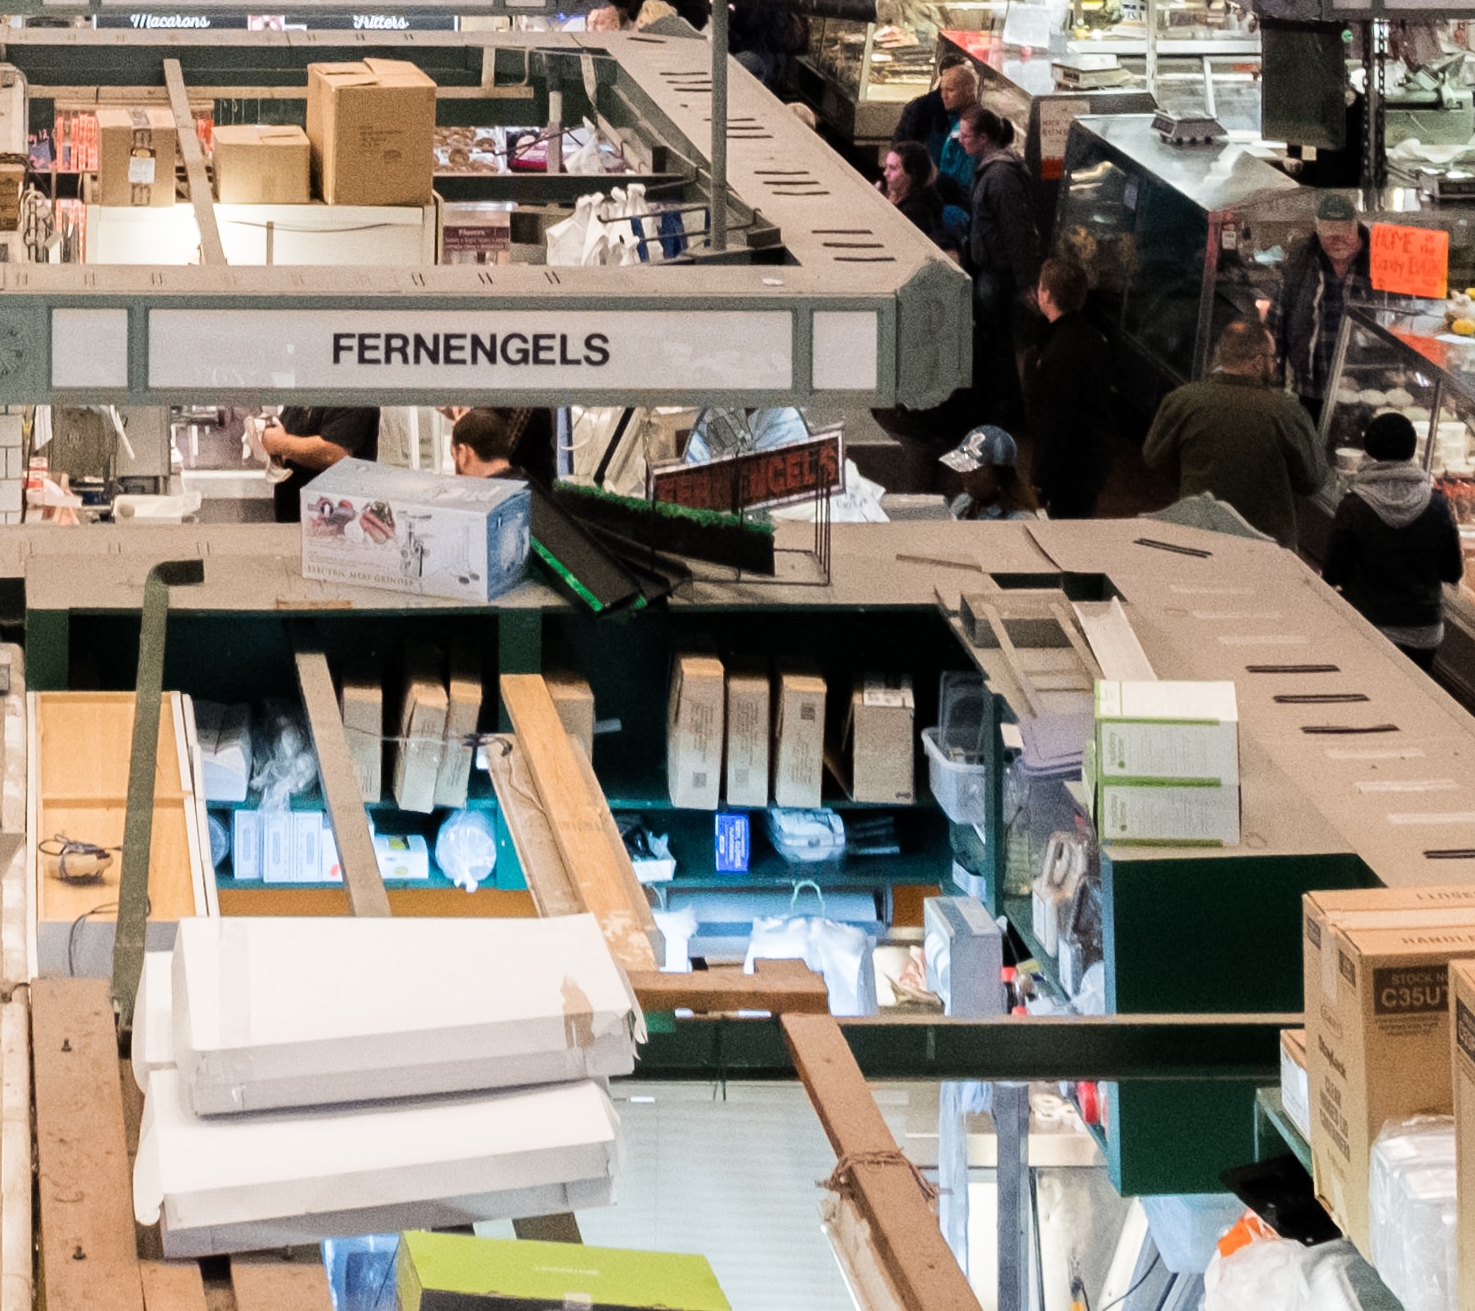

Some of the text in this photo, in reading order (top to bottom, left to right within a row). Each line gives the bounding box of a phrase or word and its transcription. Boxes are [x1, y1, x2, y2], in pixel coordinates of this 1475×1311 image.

[130, 15, 211, 29] Macarons
[352, 15, 410, 31] Fritters
[331, 331, 611, 367] FERNENGELS
[1391, 970, 1431, 986] STOCK
